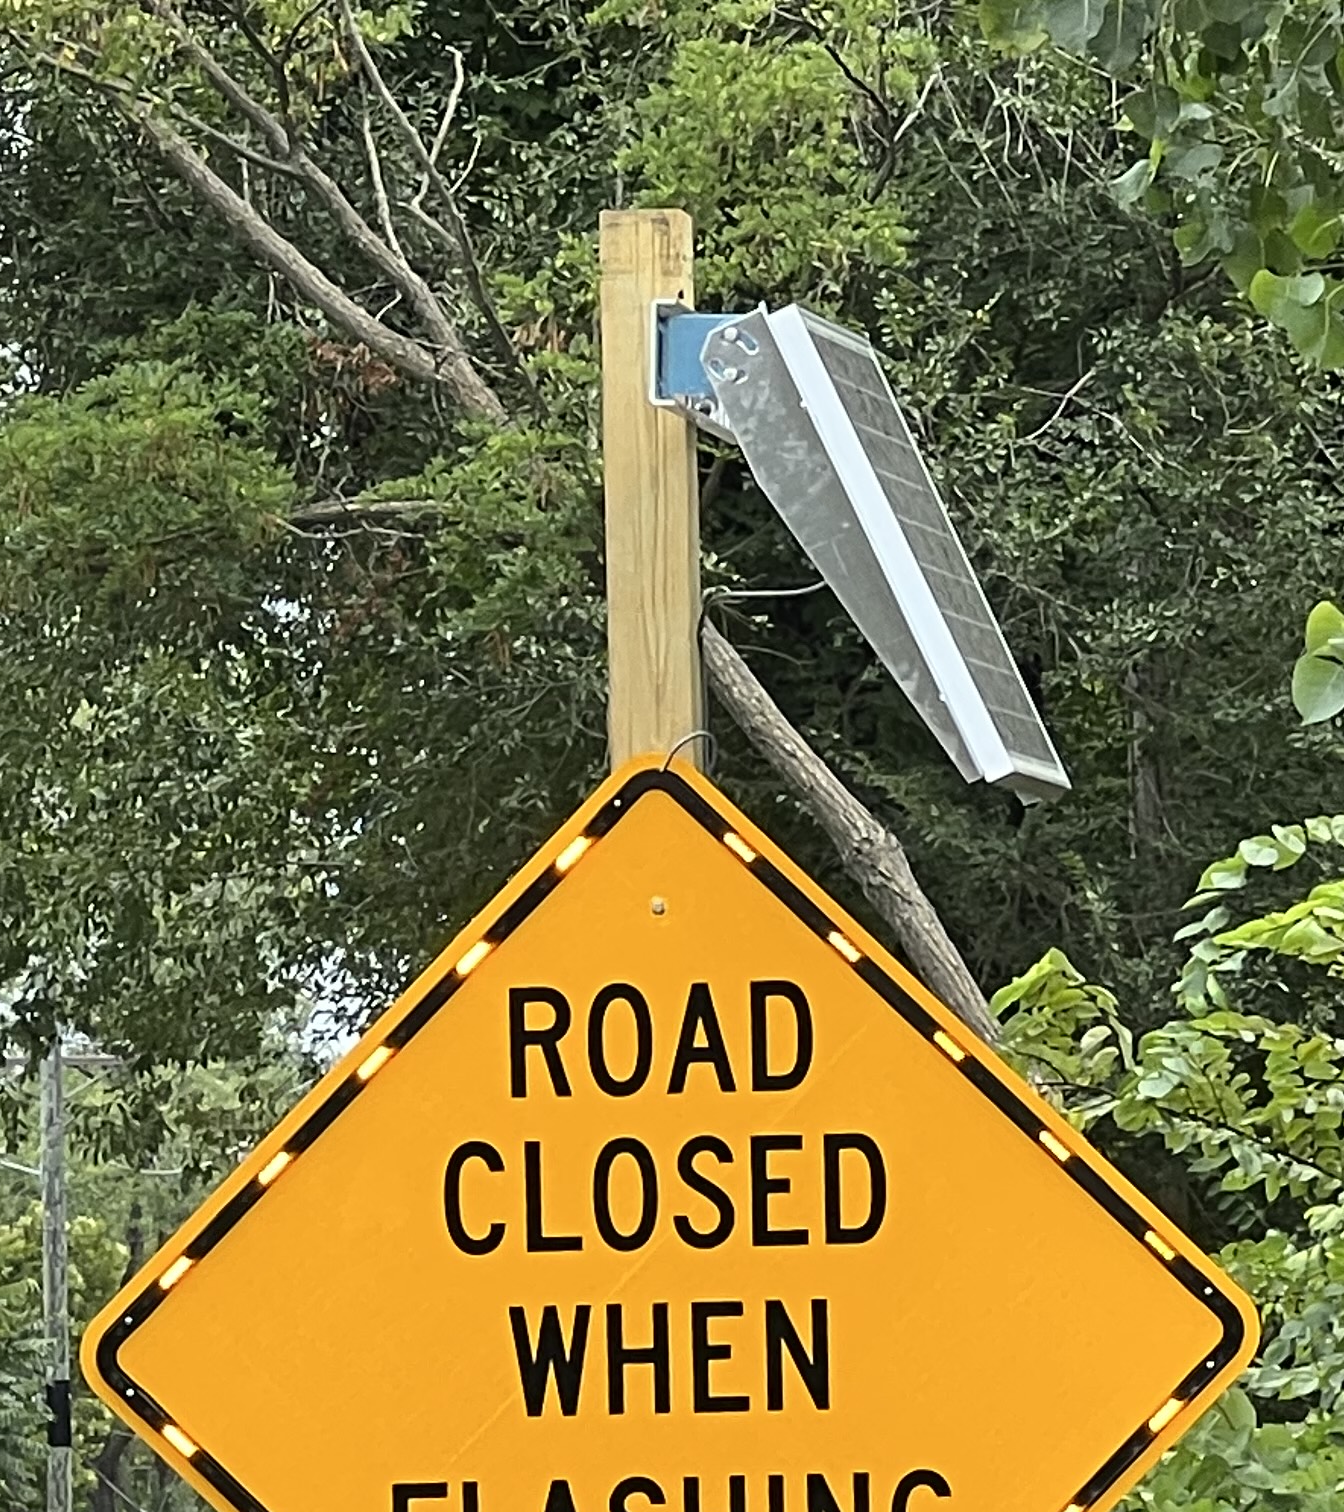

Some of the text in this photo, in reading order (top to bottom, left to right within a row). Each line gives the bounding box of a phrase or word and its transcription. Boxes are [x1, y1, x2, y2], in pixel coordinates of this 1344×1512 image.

[508, 980, 814, 1098] ROAD
[444, 1133, 887, 1256] CLOSED
[508, 1298, 830, 1417] WHEN
